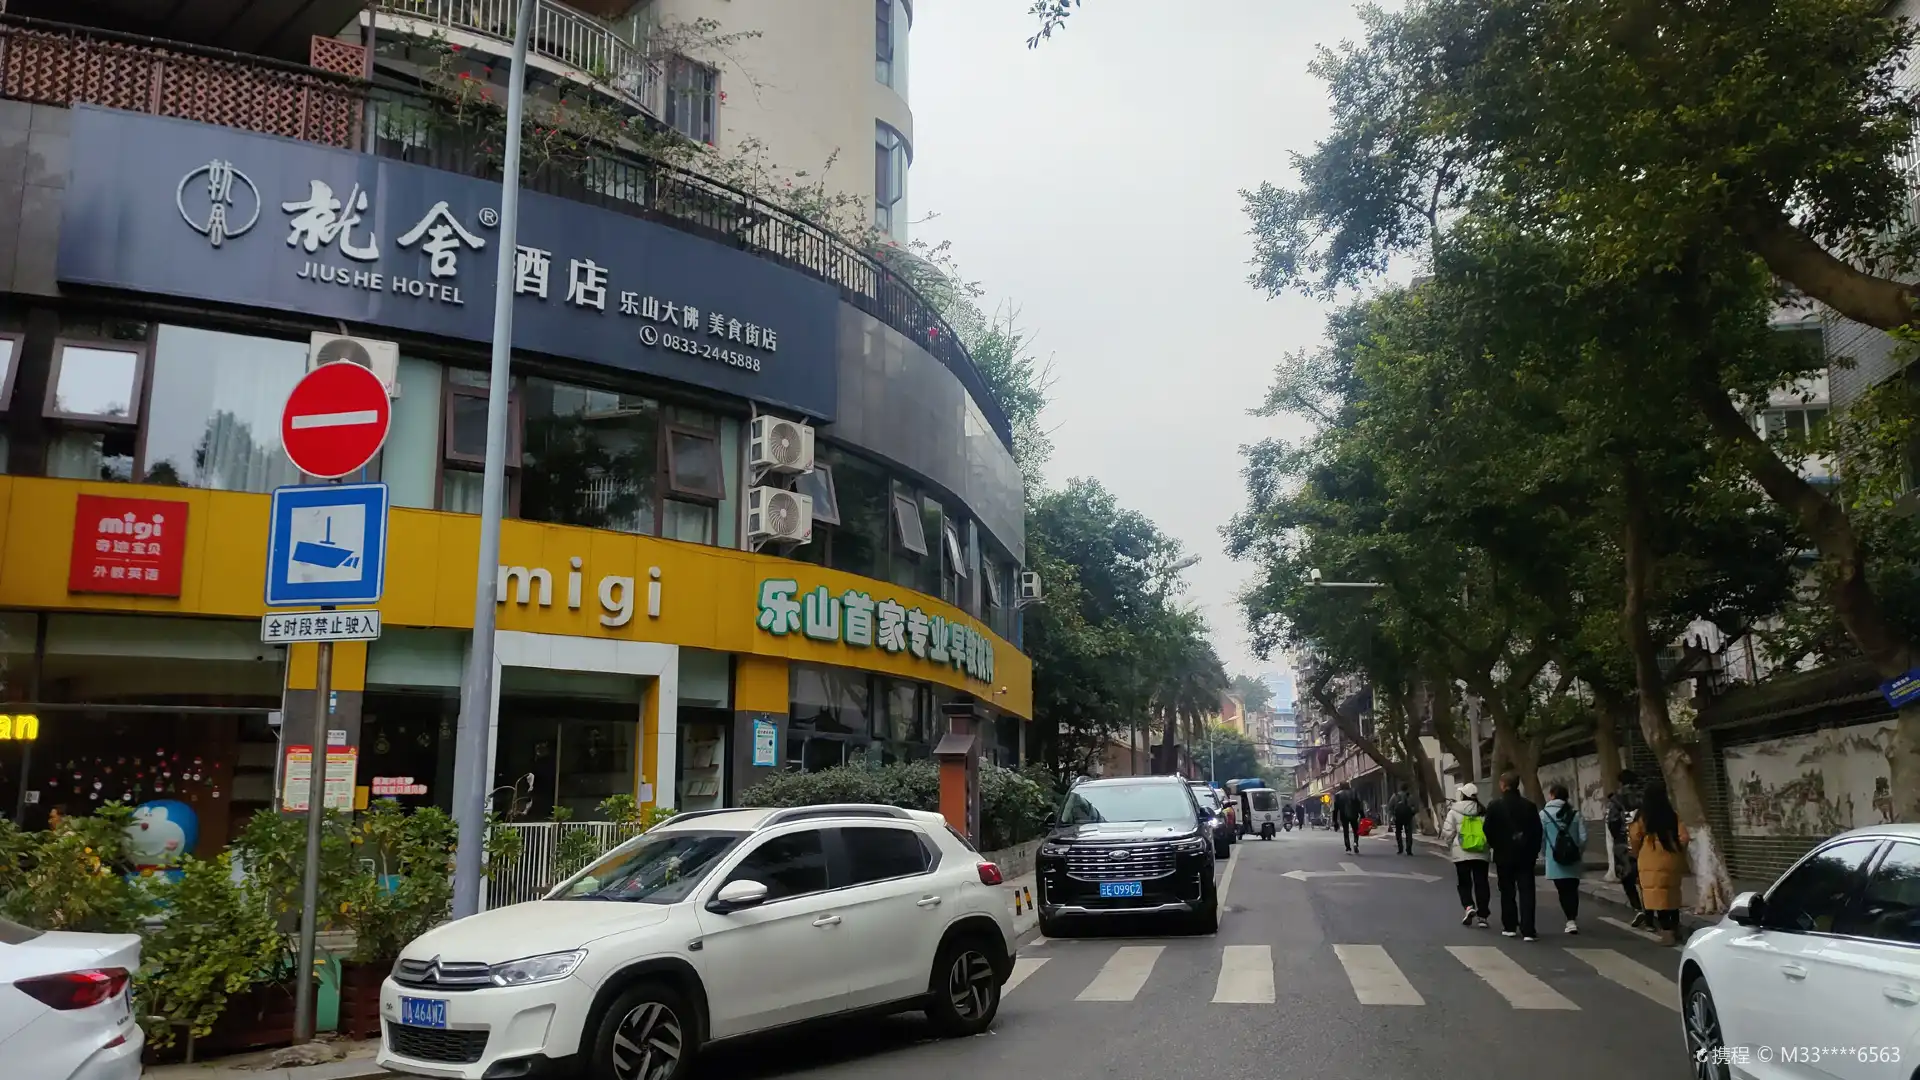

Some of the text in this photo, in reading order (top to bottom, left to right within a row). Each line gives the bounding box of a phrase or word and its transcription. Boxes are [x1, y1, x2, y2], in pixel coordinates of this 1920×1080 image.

[297, 261, 464, 305] JIUSHE HOTEL
[513, 244, 609, 311] 酒店
[619, 290, 778, 352] 乐山大佛 美食街店
[663, 332, 761, 373] 0833-2445888
[98, 512, 164, 540] migi
[93, 565, 160, 581] 外教英语
[496, 556, 662, 627] migi
[268, 615, 375, 637] 全时段禁止驶入
[756, 578, 995, 685] 乐山首家专业早教机构
